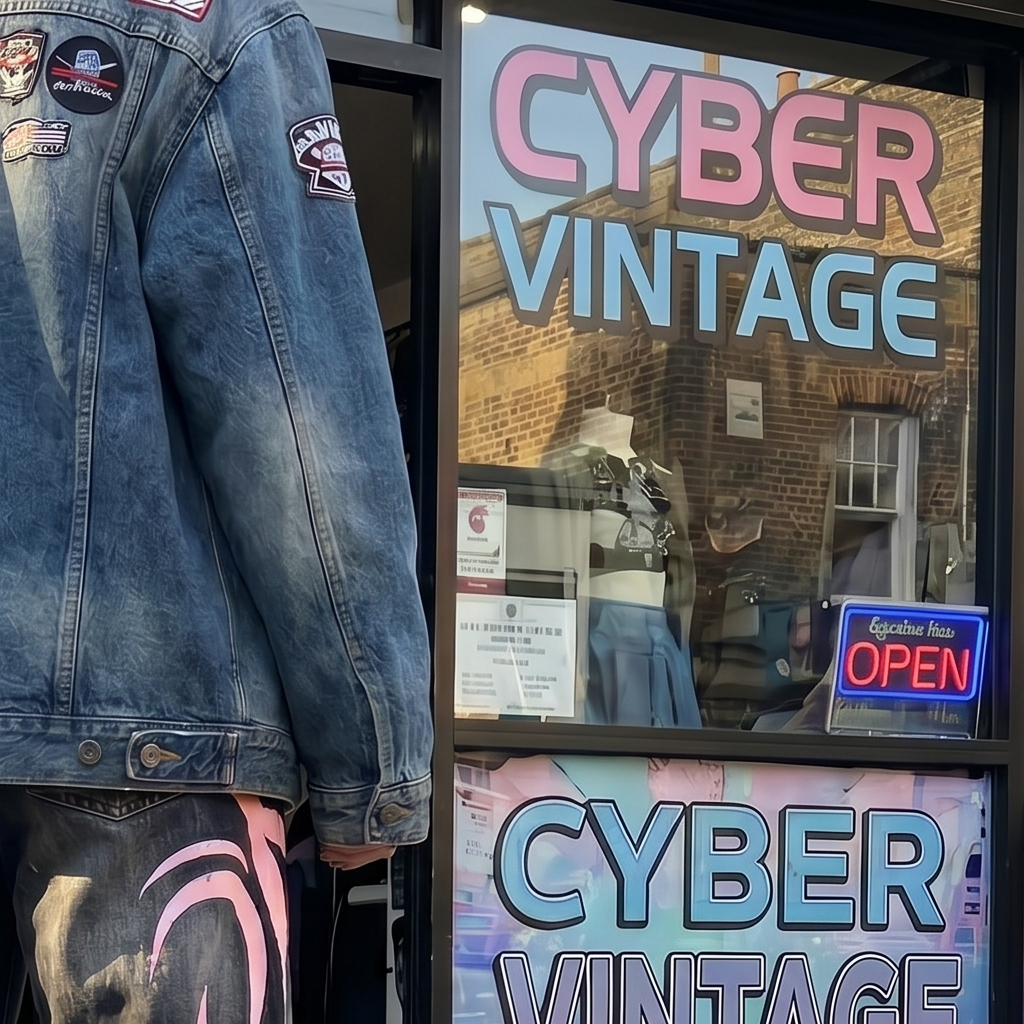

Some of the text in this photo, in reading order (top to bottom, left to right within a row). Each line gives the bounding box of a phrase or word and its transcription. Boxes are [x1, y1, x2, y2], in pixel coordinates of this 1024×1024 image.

[491, 45, 943, 247] CYBER
[484, 201, 944, 369] VINTAGE
[845, 640, 971, 692] OPEN
[494, 796, 946, 931] CYBER
